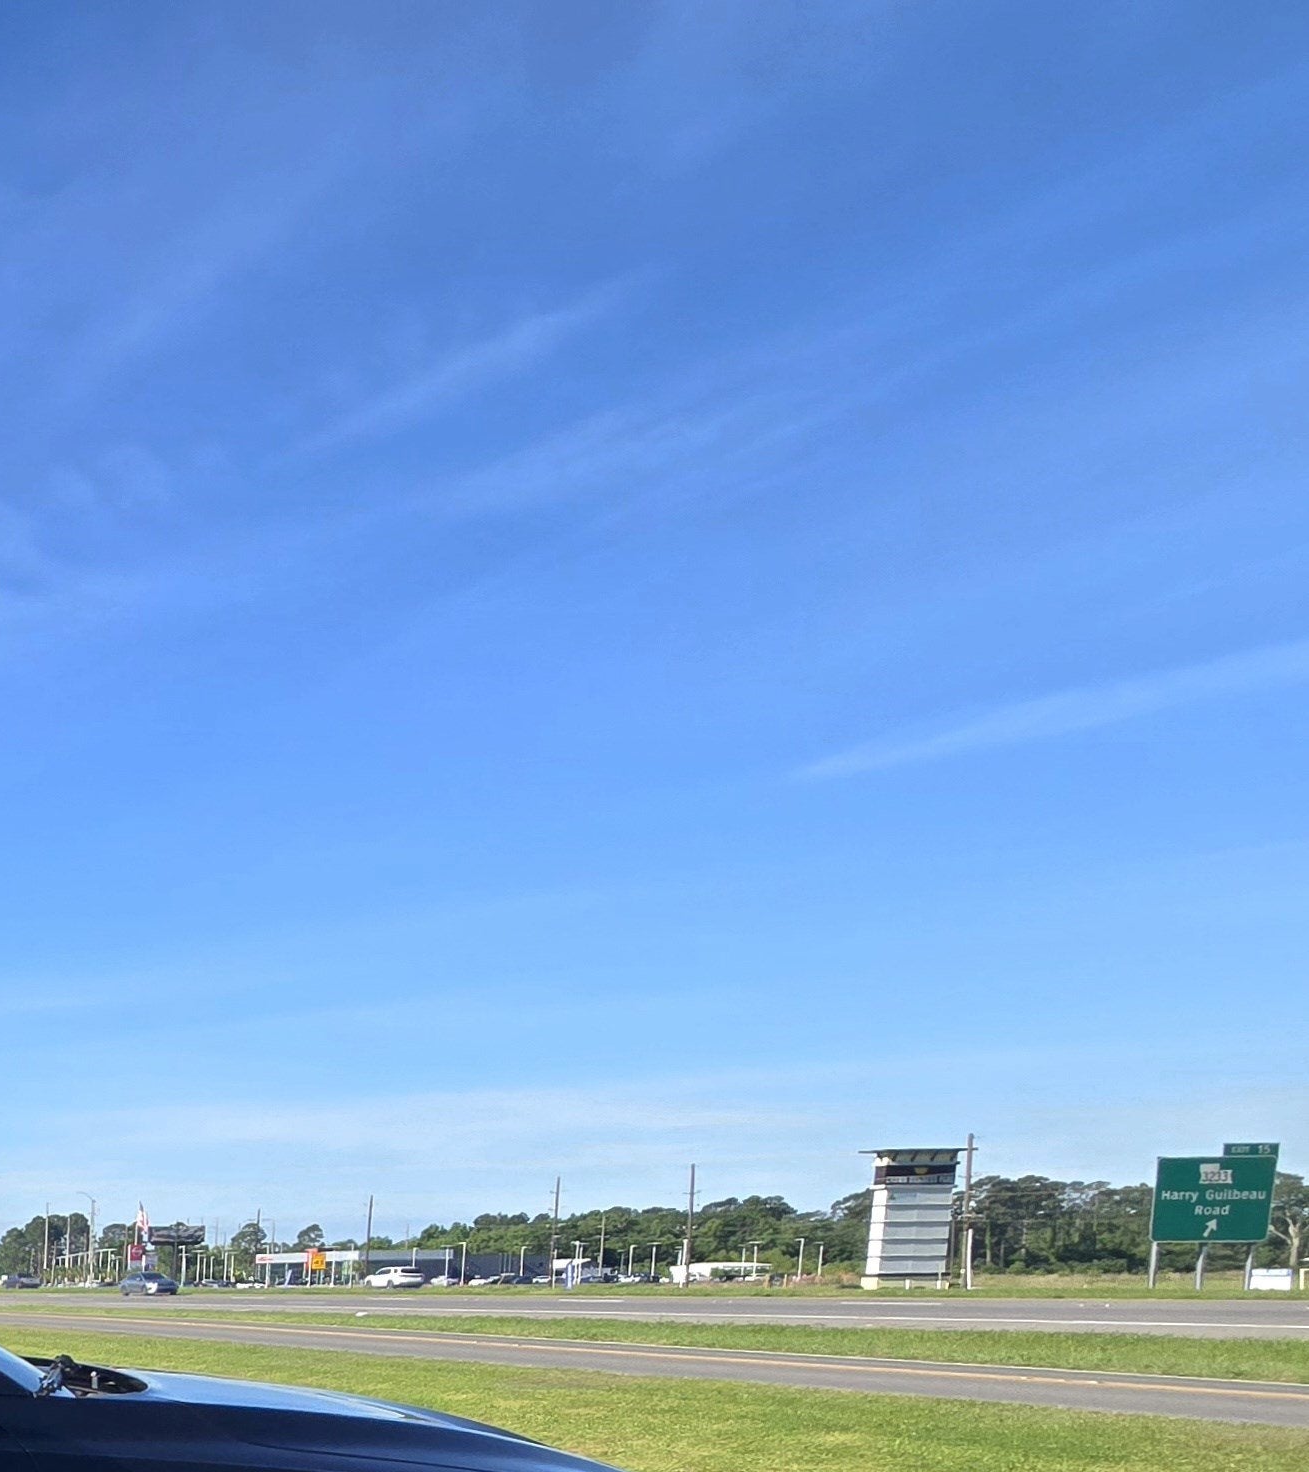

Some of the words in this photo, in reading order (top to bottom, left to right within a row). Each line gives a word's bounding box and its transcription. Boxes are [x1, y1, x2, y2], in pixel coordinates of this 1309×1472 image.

[1161, 1190, 1199, 1203] Harry
[1205, 1189, 1267, 1200] Guilbeau
[1194, 1205, 1230, 1215] Road
